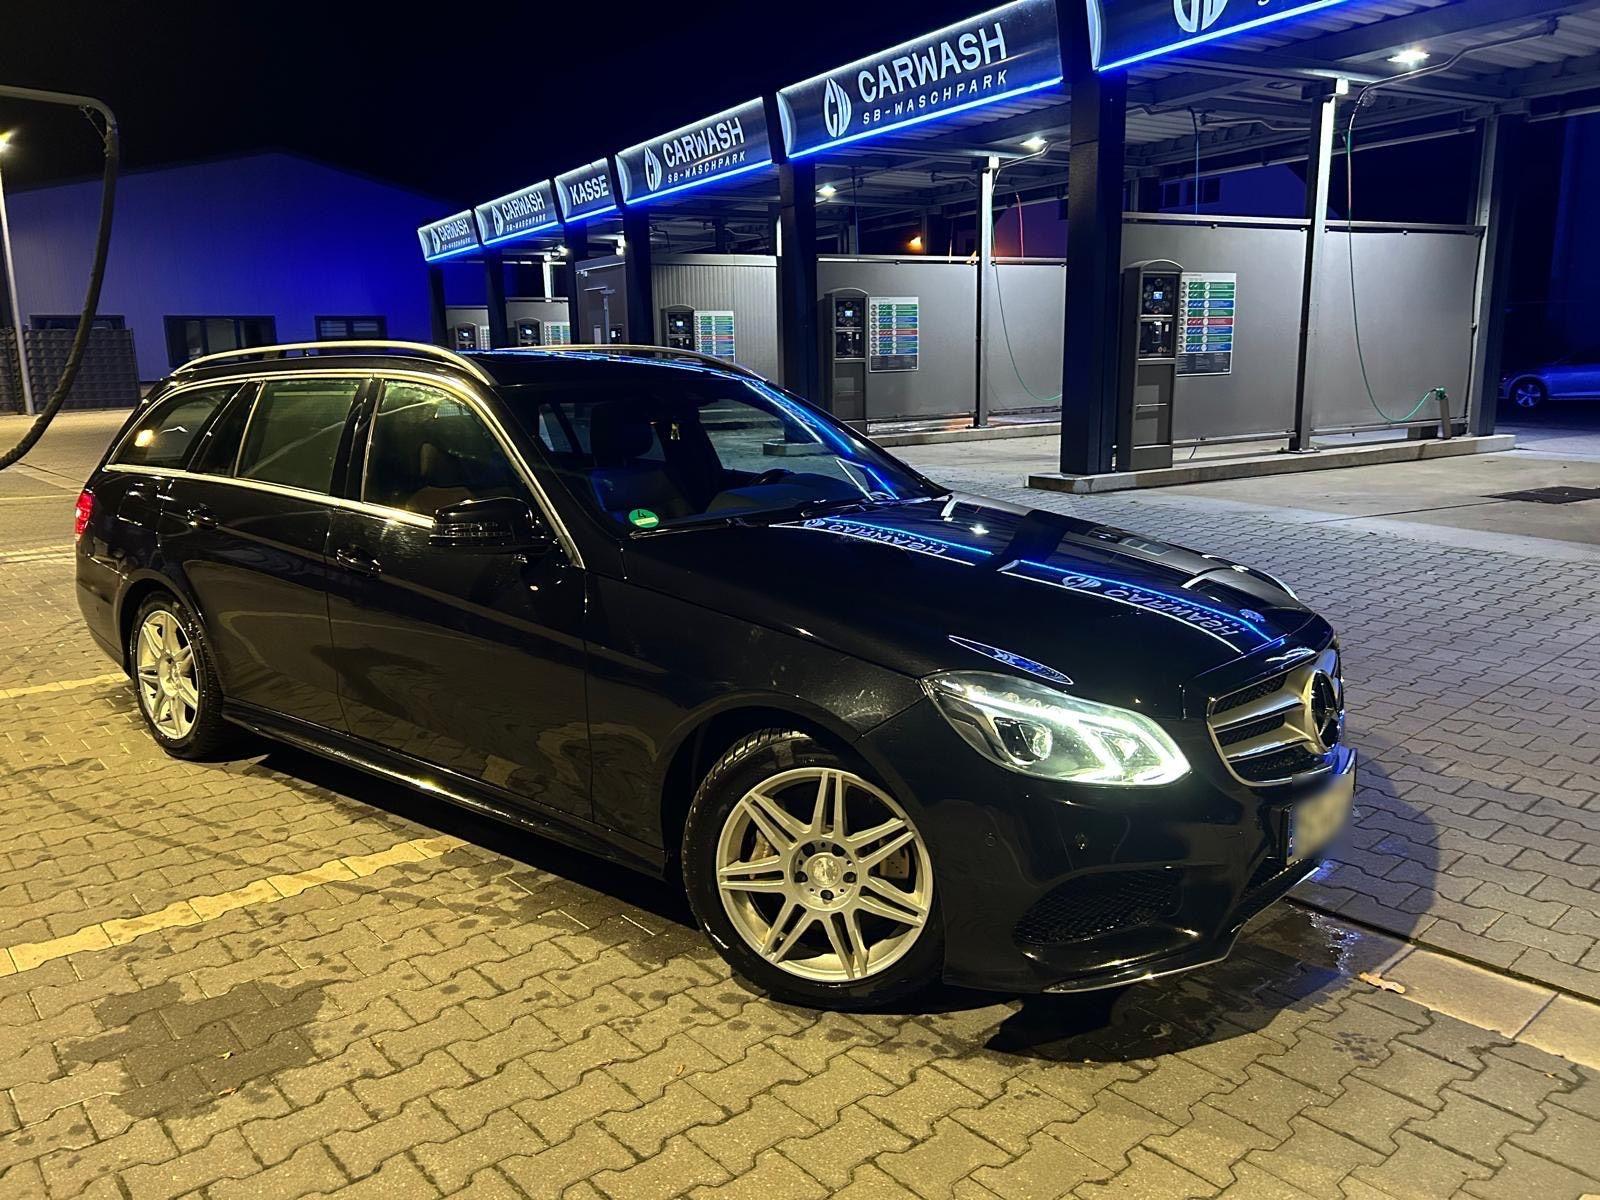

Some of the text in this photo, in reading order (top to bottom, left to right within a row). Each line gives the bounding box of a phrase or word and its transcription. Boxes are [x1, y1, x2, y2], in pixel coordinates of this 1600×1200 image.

[857, 22, 1007, 103] CARWASH
[863, 69, 1008, 125] SB-WASCHPARK
[662, 117, 745, 168] CARWASH
[668, 151, 745, 184] SB-WASCHPARK
[501, 190, 546, 221] CARWASH
[569, 174, 609, 206] KASSE
